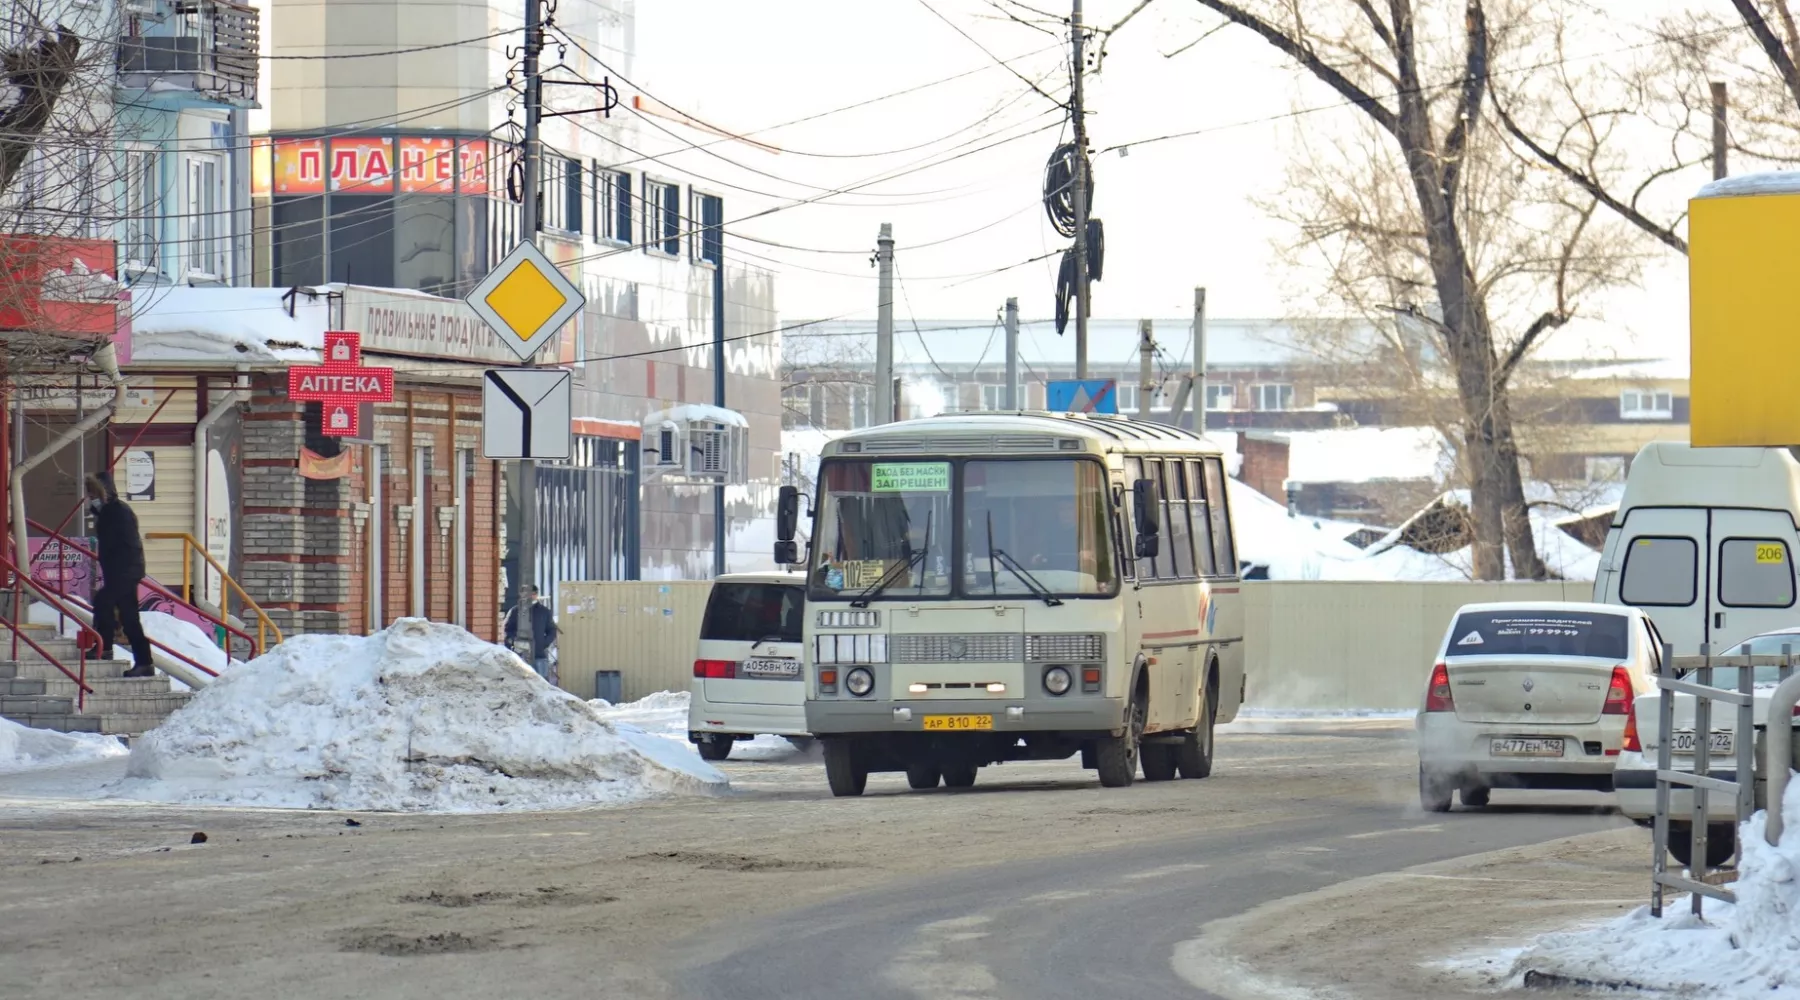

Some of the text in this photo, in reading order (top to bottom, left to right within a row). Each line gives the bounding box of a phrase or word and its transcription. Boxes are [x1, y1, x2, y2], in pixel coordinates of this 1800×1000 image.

[298, 148, 487, 182] ПЛАНЕТА
[368, 305, 437, 342] правильные
[299, 375, 382, 393] АПТЕКА
[876, 467, 945, 477] ВХОД БЕЗ МАСКИ
[876, 478, 946, 489] ЗАПРЕЩЕН!
[1757, 547, 1782, 560] 206
[844, 561, 862, 588] 102
[746, 661, 797, 671] А056ВН 122
[929, 716, 988, 728] АР 810 22
[1494, 740, 1560, 752] В477ЕН 142
[1716, 736, 1729, 746] 22
